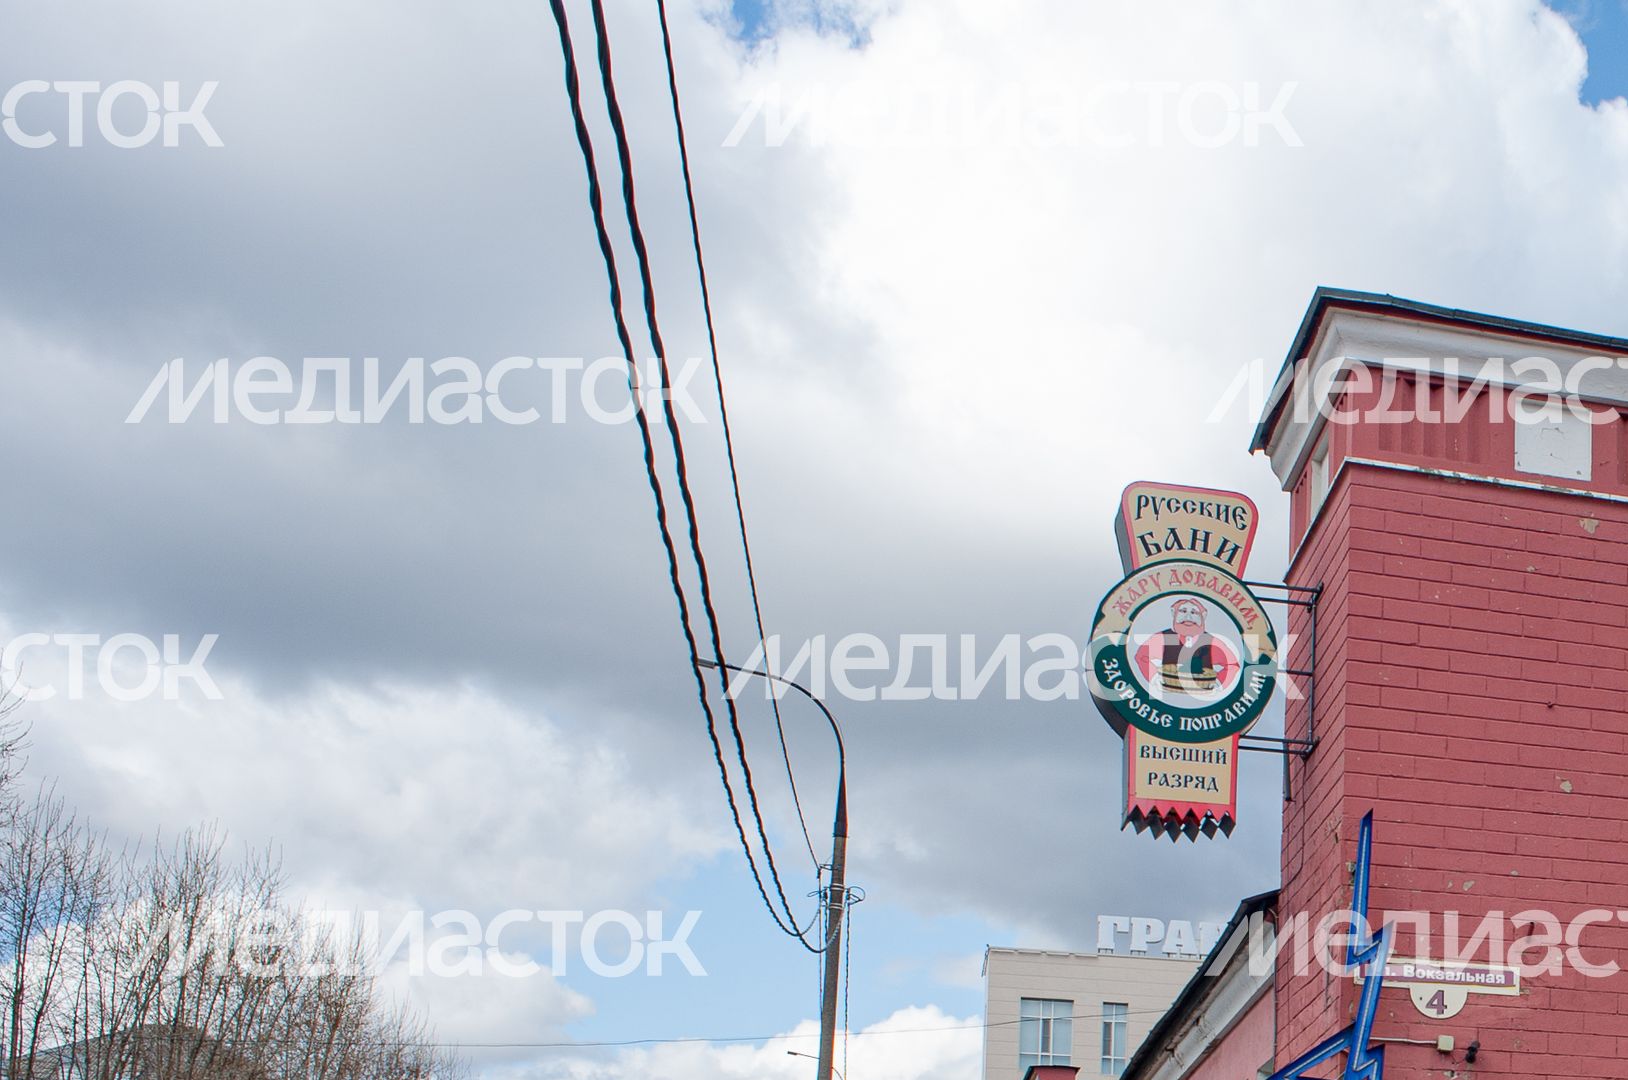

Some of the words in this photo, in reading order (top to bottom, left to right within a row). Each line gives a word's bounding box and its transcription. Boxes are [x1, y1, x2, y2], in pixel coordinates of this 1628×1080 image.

[1135, 494, 1249, 531] РУССКИЕ
[1136, 527, 1242, 566] БАНИ
[1112, 572, 1162, 617] ЖАРУ
[1101, 657, 1174, 728] ЗДОРОВЬЕ
[1179, 670, 1267, 731] ПОПРАВИМ!
[1139, 744, 1228, 765] ВЫСШИЙ
[1147, 772, 1219, 793] РАЗРЯД
[1402, 964, 1506, 985] Вокзальная
[1425, 989, 1448, 1015] 4
